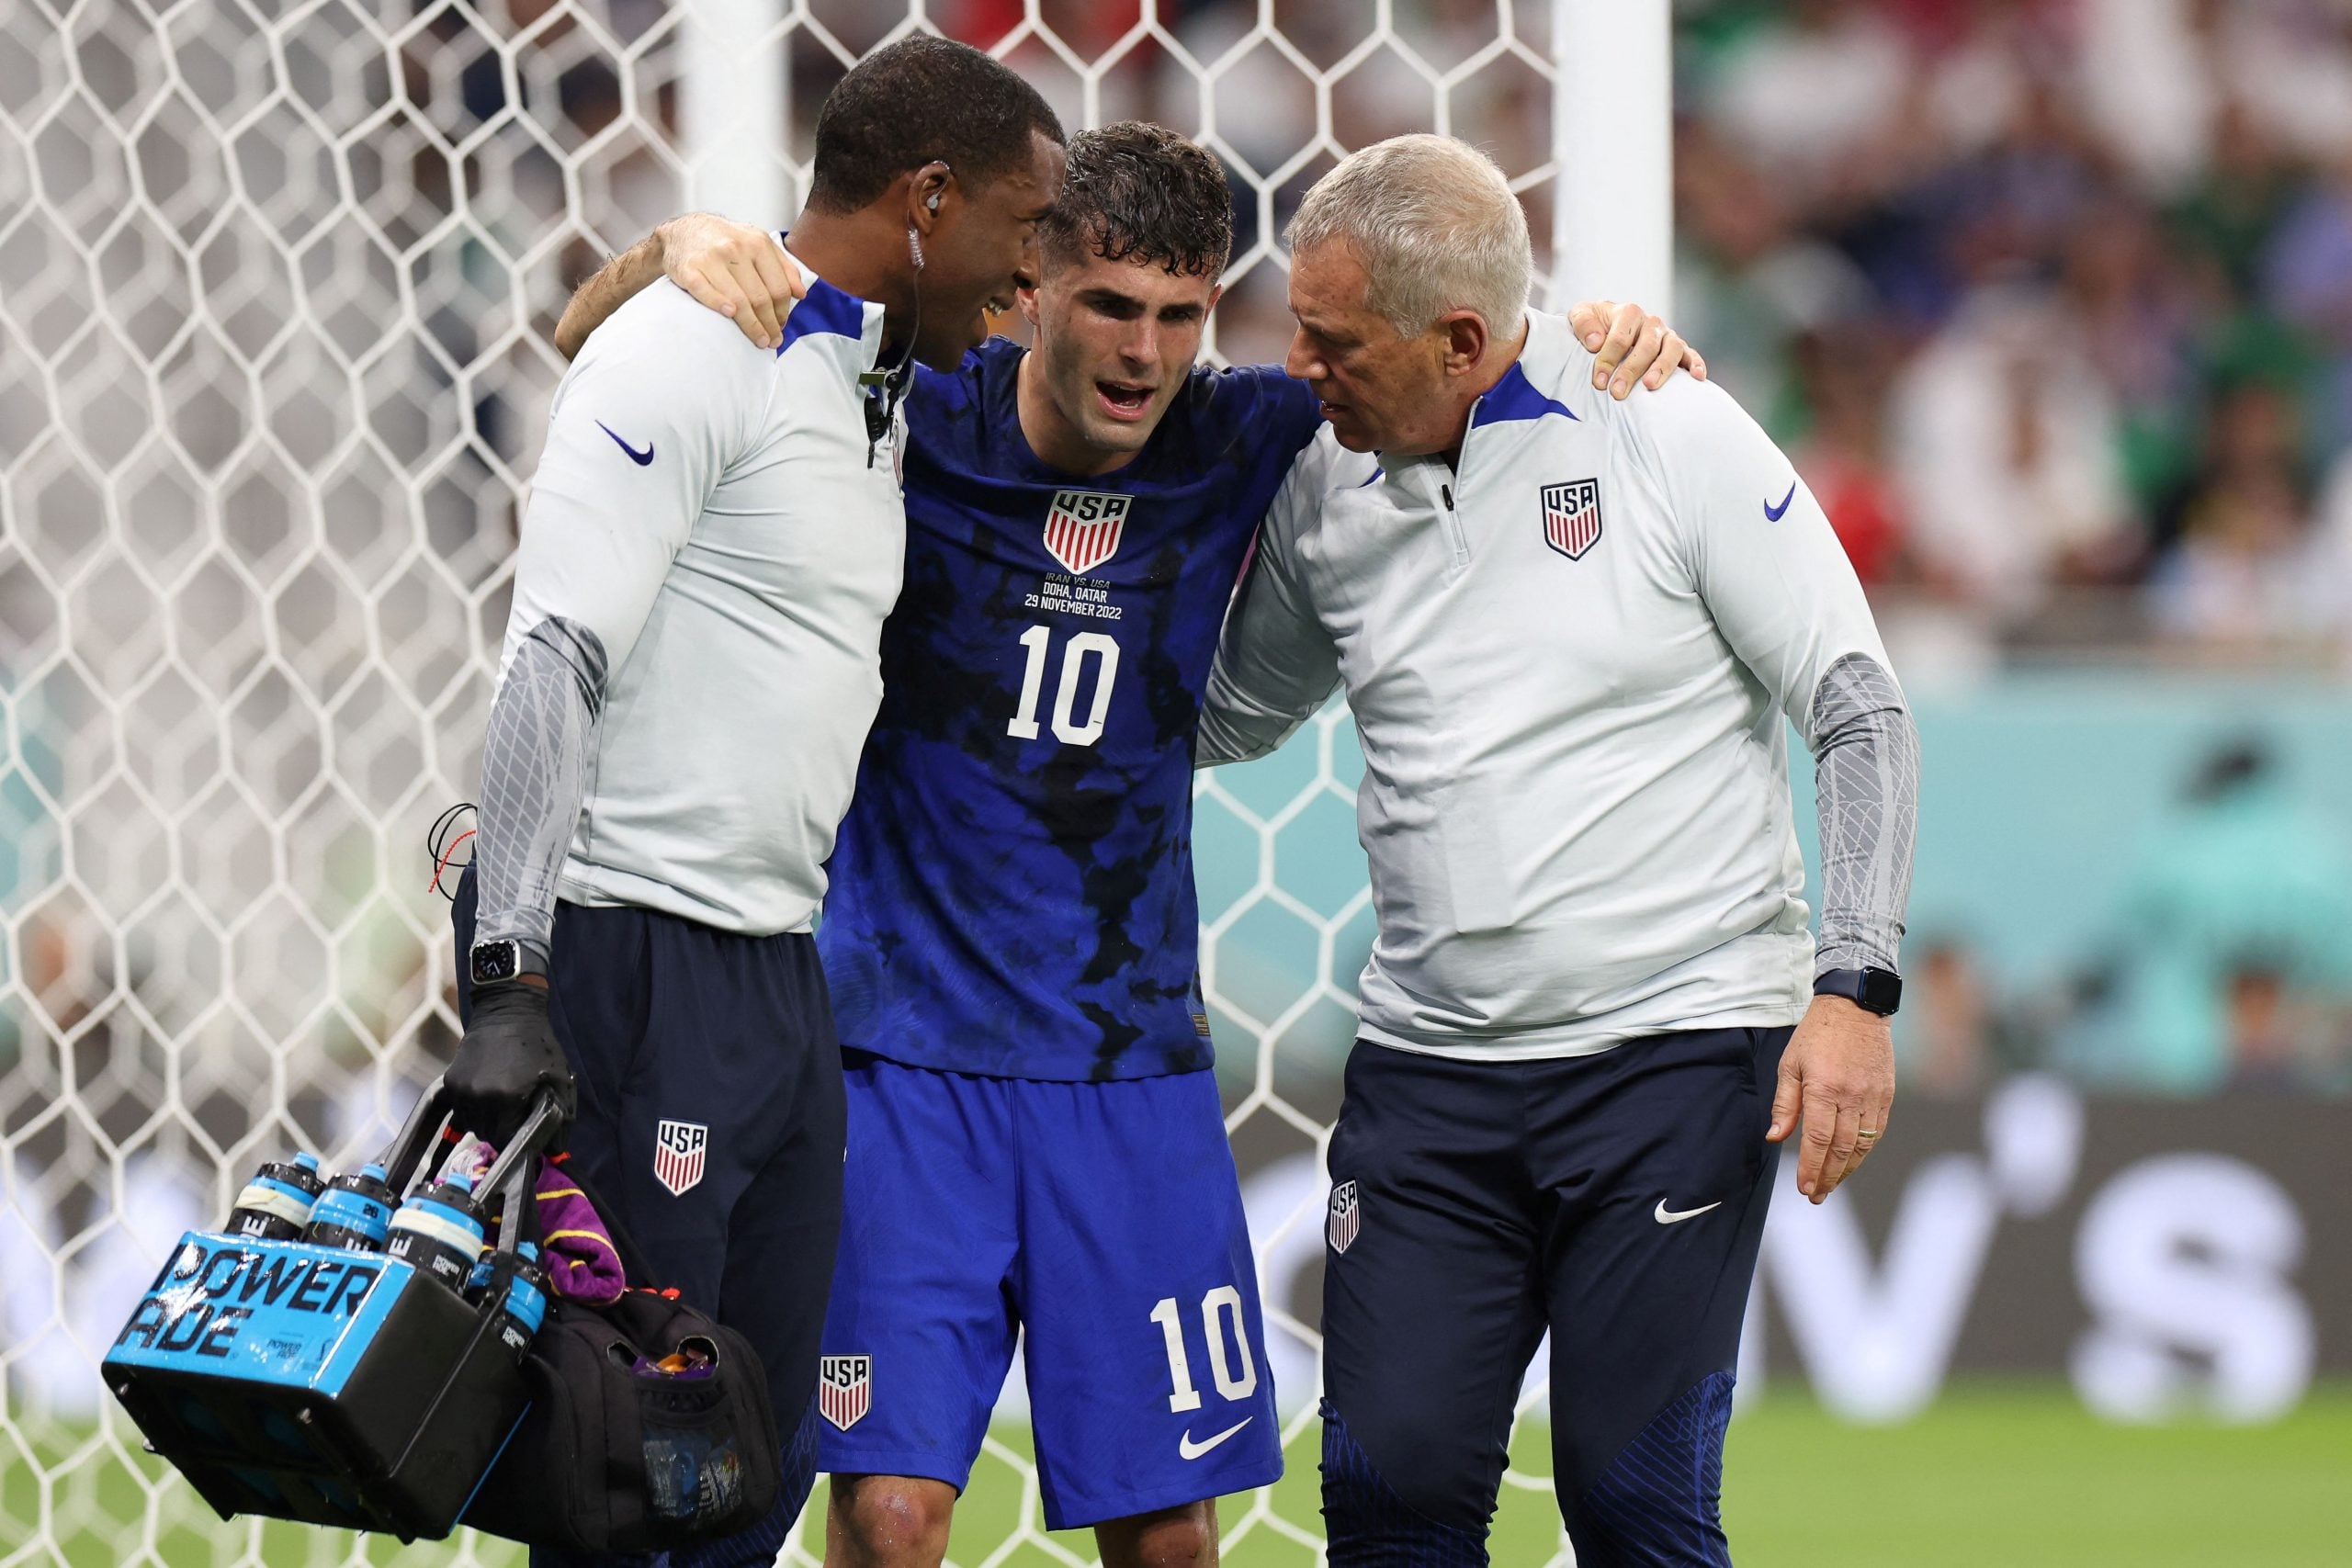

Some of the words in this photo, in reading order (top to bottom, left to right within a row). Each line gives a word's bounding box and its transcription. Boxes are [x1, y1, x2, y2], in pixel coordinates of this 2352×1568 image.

[1057, 493, 1126, 521] USA
[1547, 485, 1593, 515] USA
[1043, 581, 1072, 600] DOHA,
[1075, 586, 1108, 604] QATAR
[1046, 572, 1070, 583] IRAN
[1091, 579, 1110, 589] USA
[1024, 593, 1039, 607] 29
[1041, 596, 1095, 616] NOVEMBER
[1096, 604, 1122, 620] 2022
[1007, 625, 1121, 746] 10
[661, 1123, 705, 1154] USA
[1333, 1183, 1356, 1214] USA
[150, 1243, 382, 1317] POWER
[116, 1297, 254, 1359] ADE
[1149, 1284, 1257, 1414] 10
[823, 1359, 866, 1388] USA
